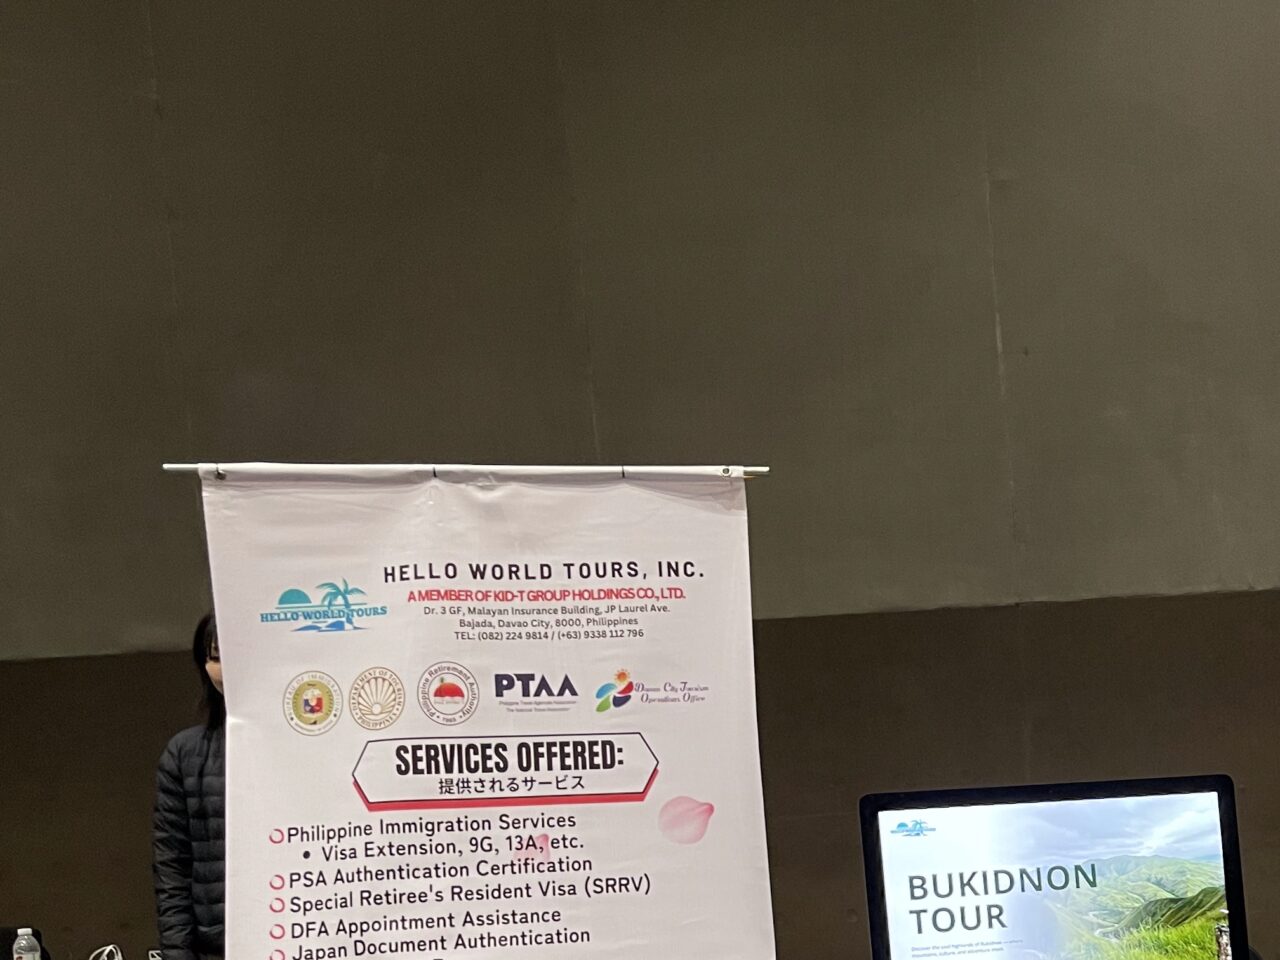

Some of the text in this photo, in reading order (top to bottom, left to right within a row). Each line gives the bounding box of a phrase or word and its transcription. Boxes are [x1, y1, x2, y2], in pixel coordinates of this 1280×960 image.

[384, 561, 704, 583] HELLO WORLD TOURS, INC.
[408, 591, 416, 602] A
[418, 590, 473, 602] MEMBER
[475, 590, 491, 601] OF
[494, 590, 525, 601] KID-T
[527, 589, 570, 601] GROUP
[573, 587, 635, 600] HOLDINGS
[661, 587, 686, 599] LTD.
[260, 606, 387, 622] HELLO WORLD TOURS
[424, 604, 671, 617] Dr. 3 GF, Malayan Insurance Building, JP Laurel Ave.
[459, 617, 638, 630] Bajada, Davao City, 8000, Philippines
[455, 629, 644, 641] TEL: (082) 224 9814 / (+63) 9338 112 796
[428, 665, 471, 682] Retirement
[494, 673, 579, 698] PTAA
[395, 739, 624, 776] SERVICES OFFERED:
[438, 774, 585, 795] 提供されるサービス
[287, 812, 576, 844] Philippine Immigration Services
[322, 834, 584, 862] Visa Extension, 9G, 13A, etc.
[289, 856, 592, 889] PSA Authentication Certification
[908, 863, 1098, 901] BUKIDNON
[290, 873, 651, 916] Special Retiree's Resident Visa (SRRV)
[291, 909, 561, 939] DFA Appointment Assistance
[909, 903, 1008, 935] TOUR
[354, 935, 447, 956] Document
[454, 928, 590, 950] Authentication
